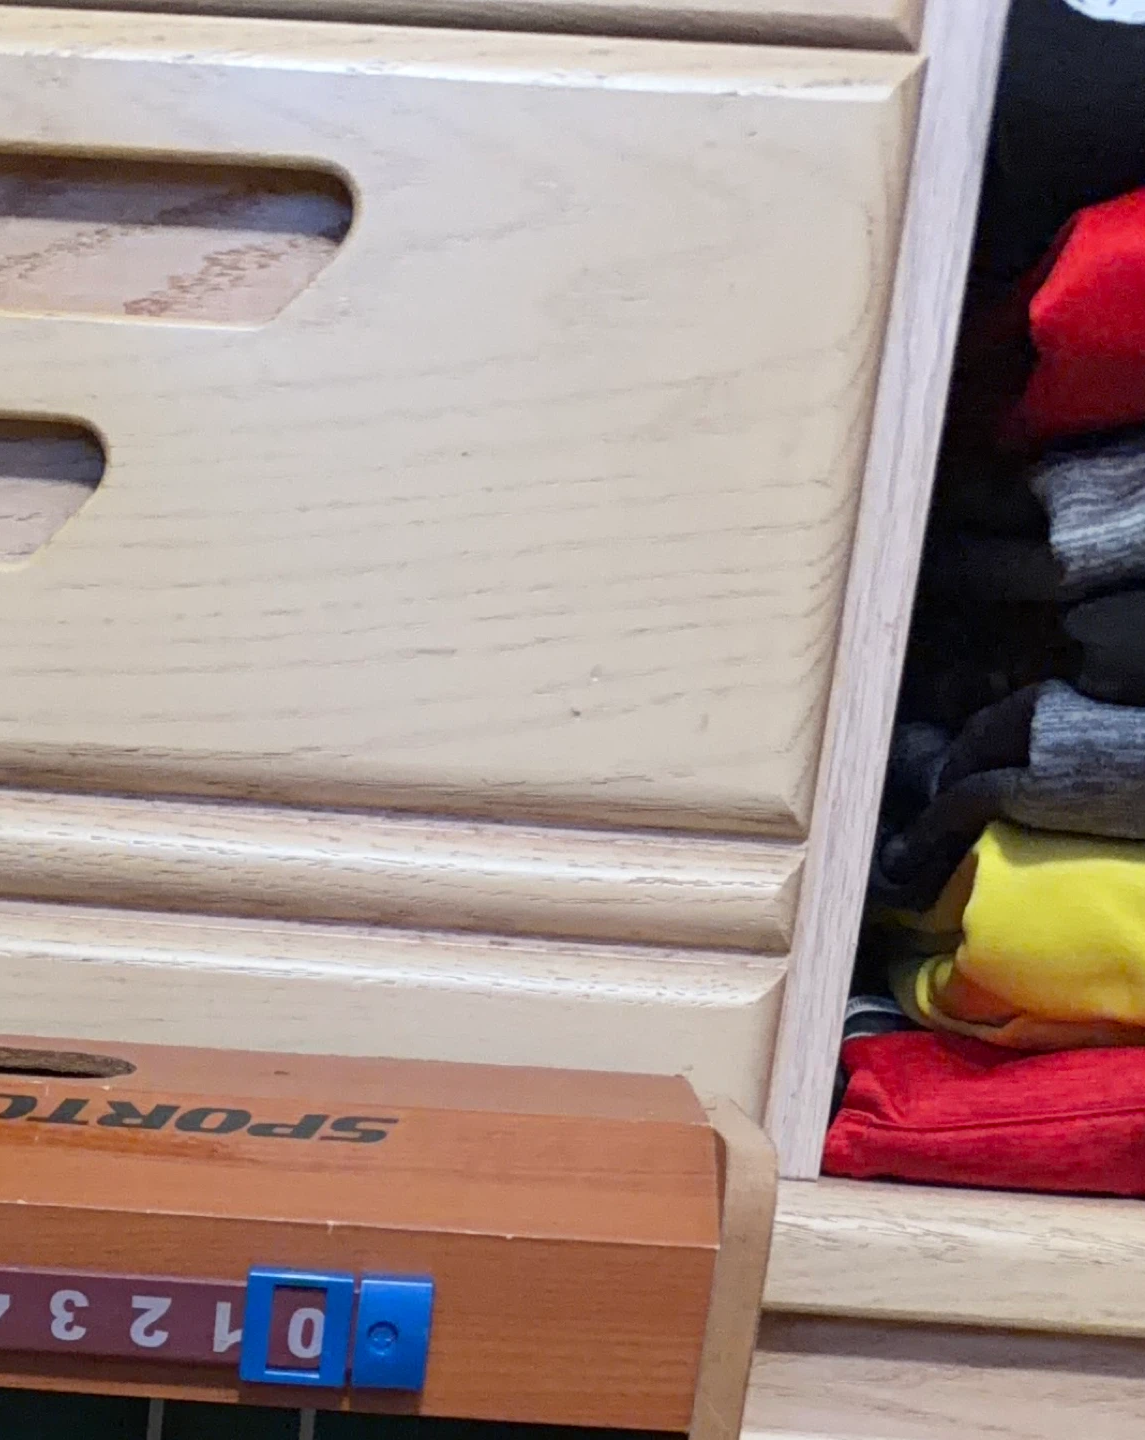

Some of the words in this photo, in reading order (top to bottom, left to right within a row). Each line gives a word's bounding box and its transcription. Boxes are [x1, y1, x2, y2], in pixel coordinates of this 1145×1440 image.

[50, 1289, 89, 1341] 3
[129, 1296, 172, 1348] 2
[212, 1301, 243, 1353] 1
[287, 1307, 325, 1359] 0
